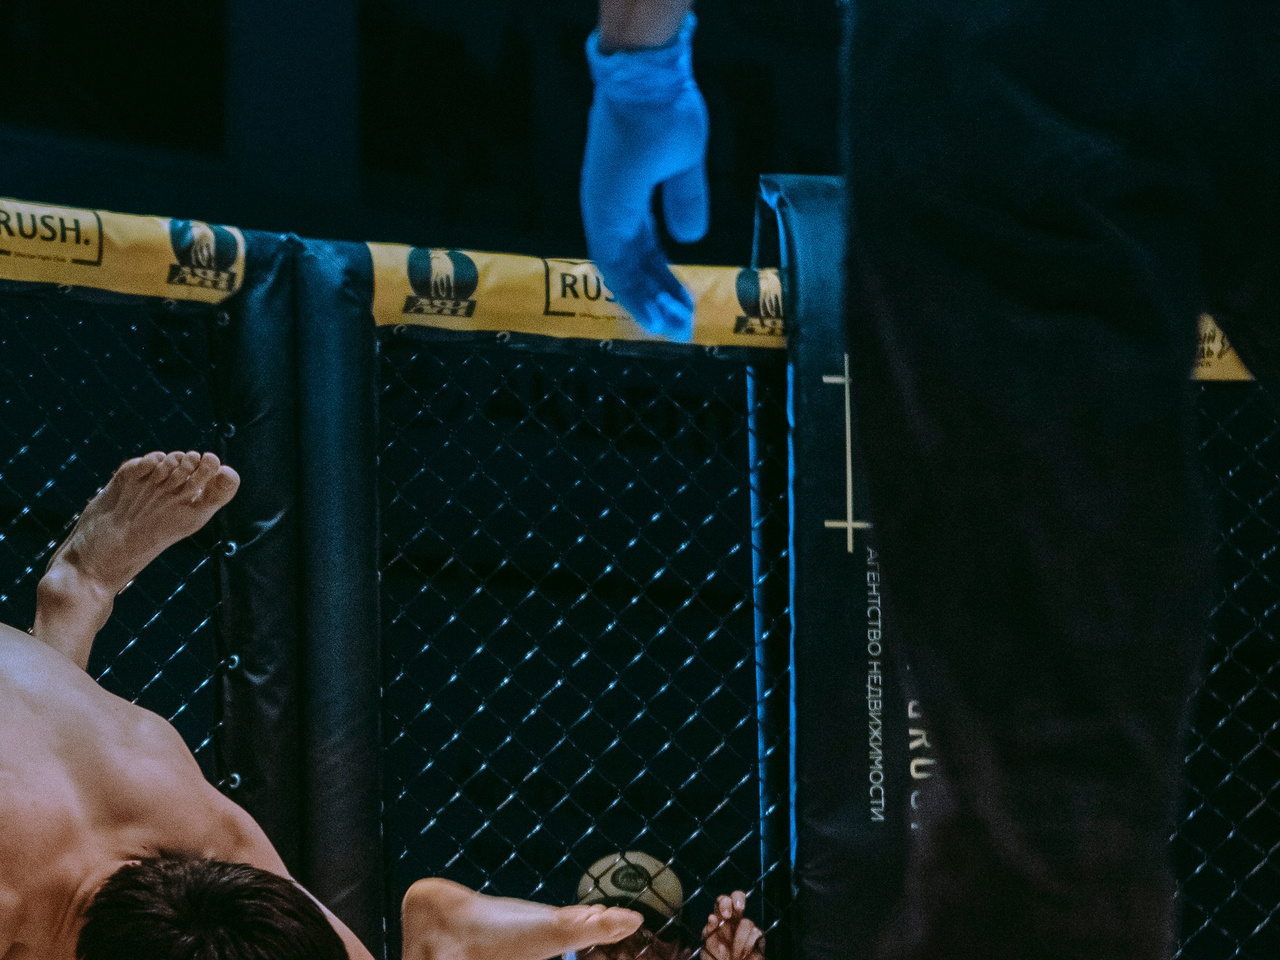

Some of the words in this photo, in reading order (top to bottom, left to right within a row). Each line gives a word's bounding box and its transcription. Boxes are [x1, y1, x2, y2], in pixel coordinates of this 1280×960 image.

[560, 272, 616, 302] RU
[865, 546, 883, 656] АГЕНТСТВО
[865, 660, 886, 822] НЕДВИЖИМОСТИ
